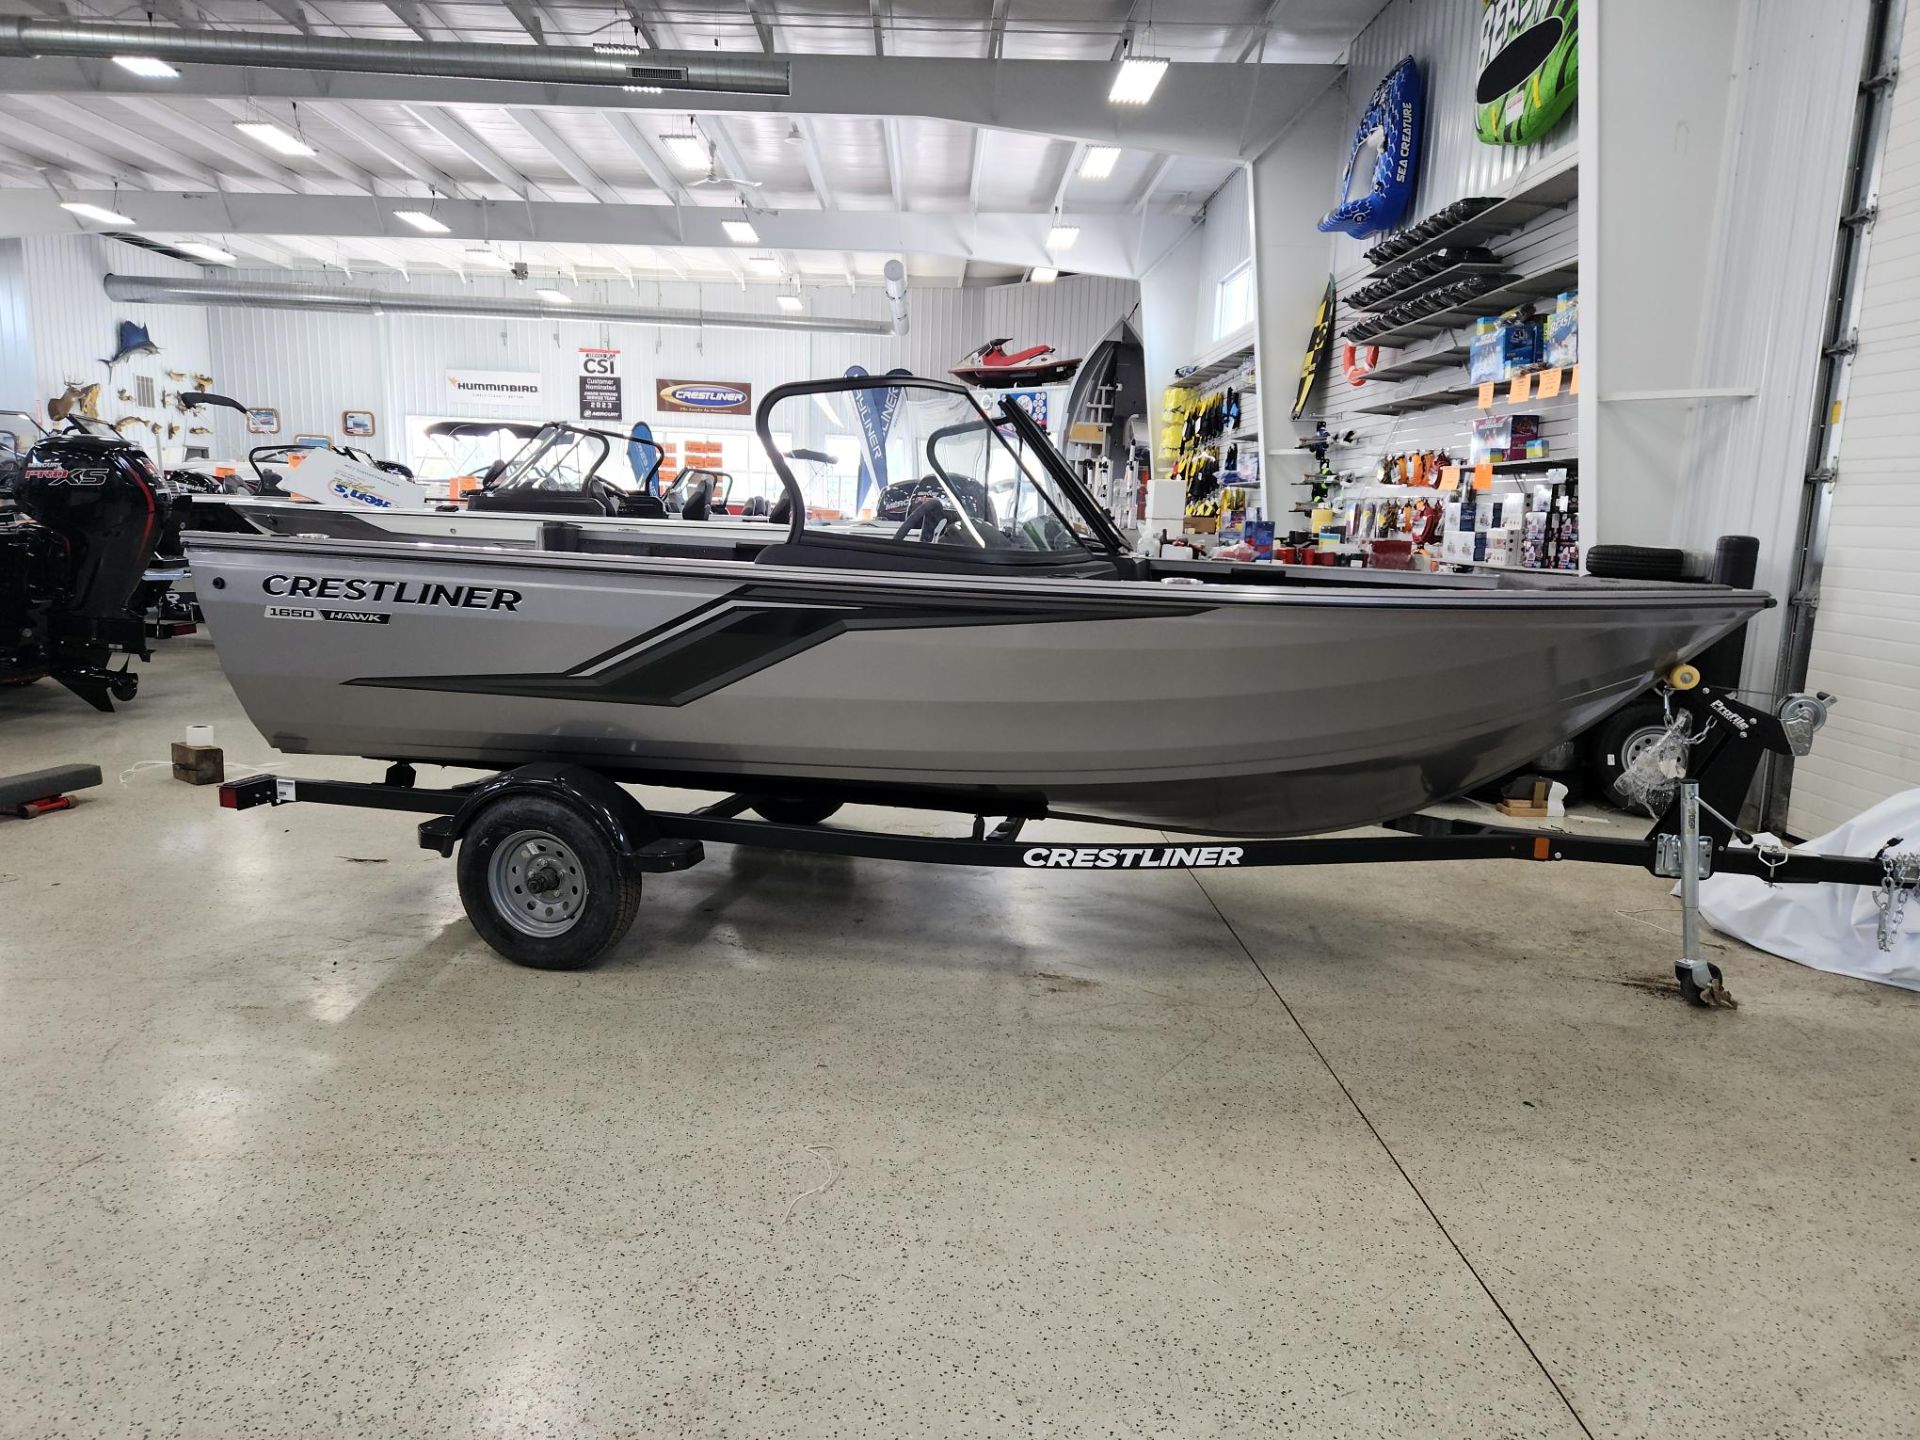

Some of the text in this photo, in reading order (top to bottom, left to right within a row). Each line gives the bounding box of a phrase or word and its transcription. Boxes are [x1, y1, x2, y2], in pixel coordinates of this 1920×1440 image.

[1396, 102, 1412, 183] SEA CREATURE
[583, 358, 615, 374] CSI
[457, 382, 538, 393] HUMMINBIRD
[675, 391, 744, 402] CRESTLINER
[262, 574, 523, 612] CRESTLINER
[270, 608, 382, 622] 1650 HAWK
[1710, 699, 1749, 729] Profile
[1022, 846, 1244, 867] CRESTLINER
